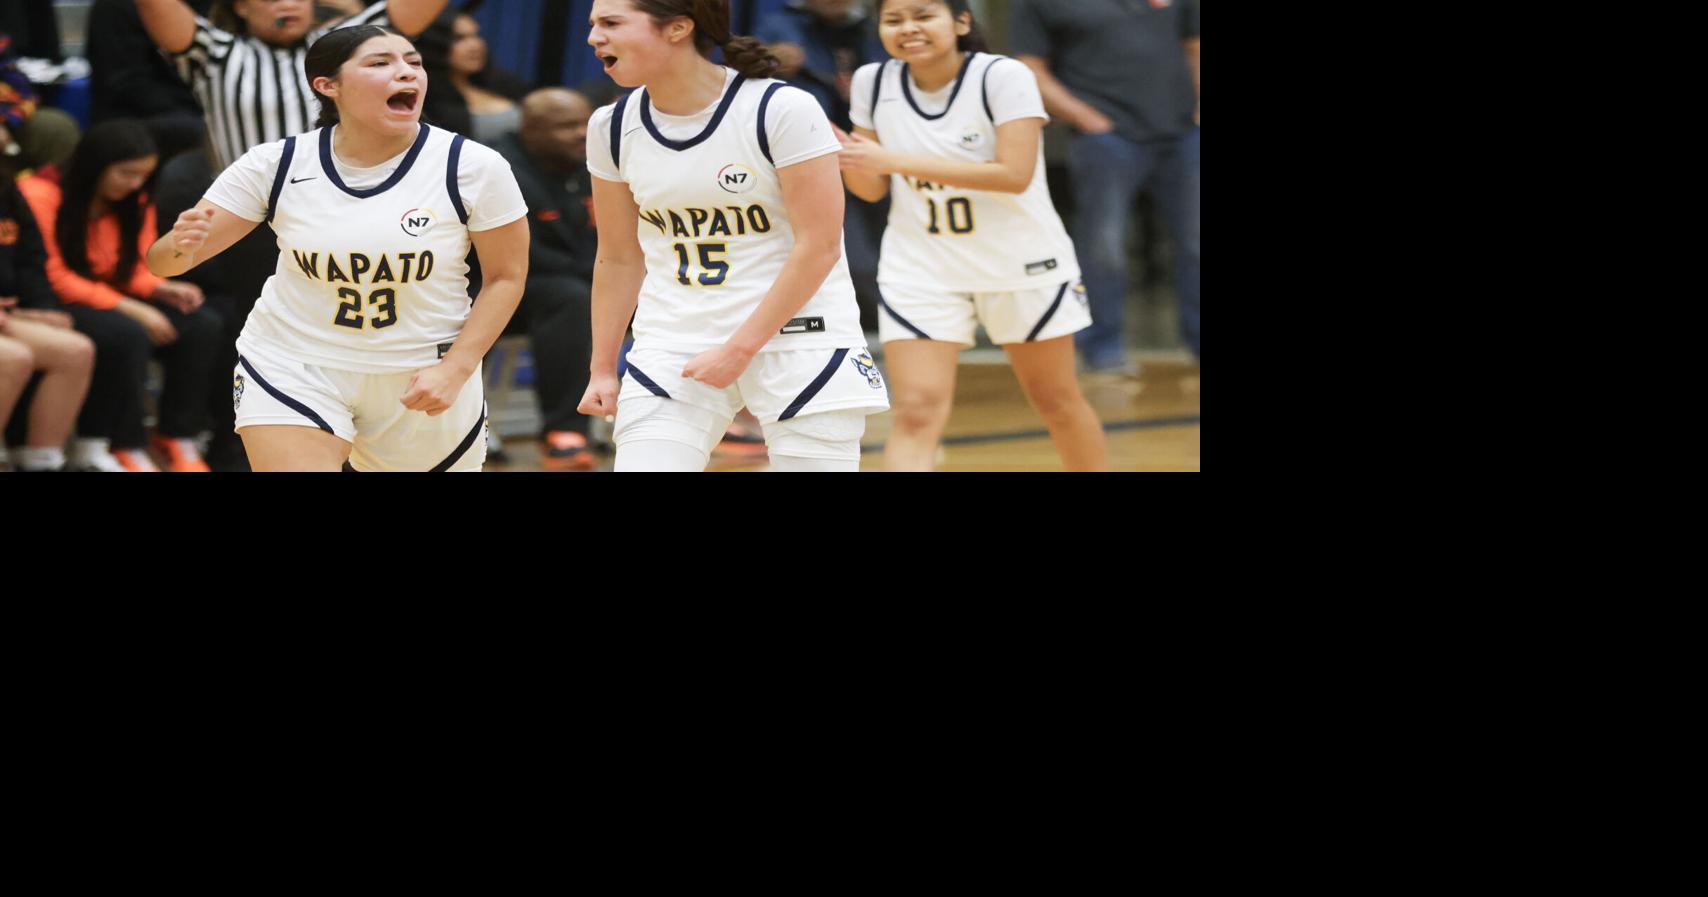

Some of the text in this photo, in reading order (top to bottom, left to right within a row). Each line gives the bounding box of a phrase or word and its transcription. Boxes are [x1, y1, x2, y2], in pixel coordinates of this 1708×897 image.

[725, 172, 748, 185] N7
[408, 217, 430, 228] N7
[639, 203, 772, 238] WAPATO
[926, 195, 975, 236] 10
[291, 249, 435, 285] WAPATO
[672, 241, 731, 287] 15
[333, 285, 399, 331] 23
[810, 320, 820, 329] M
